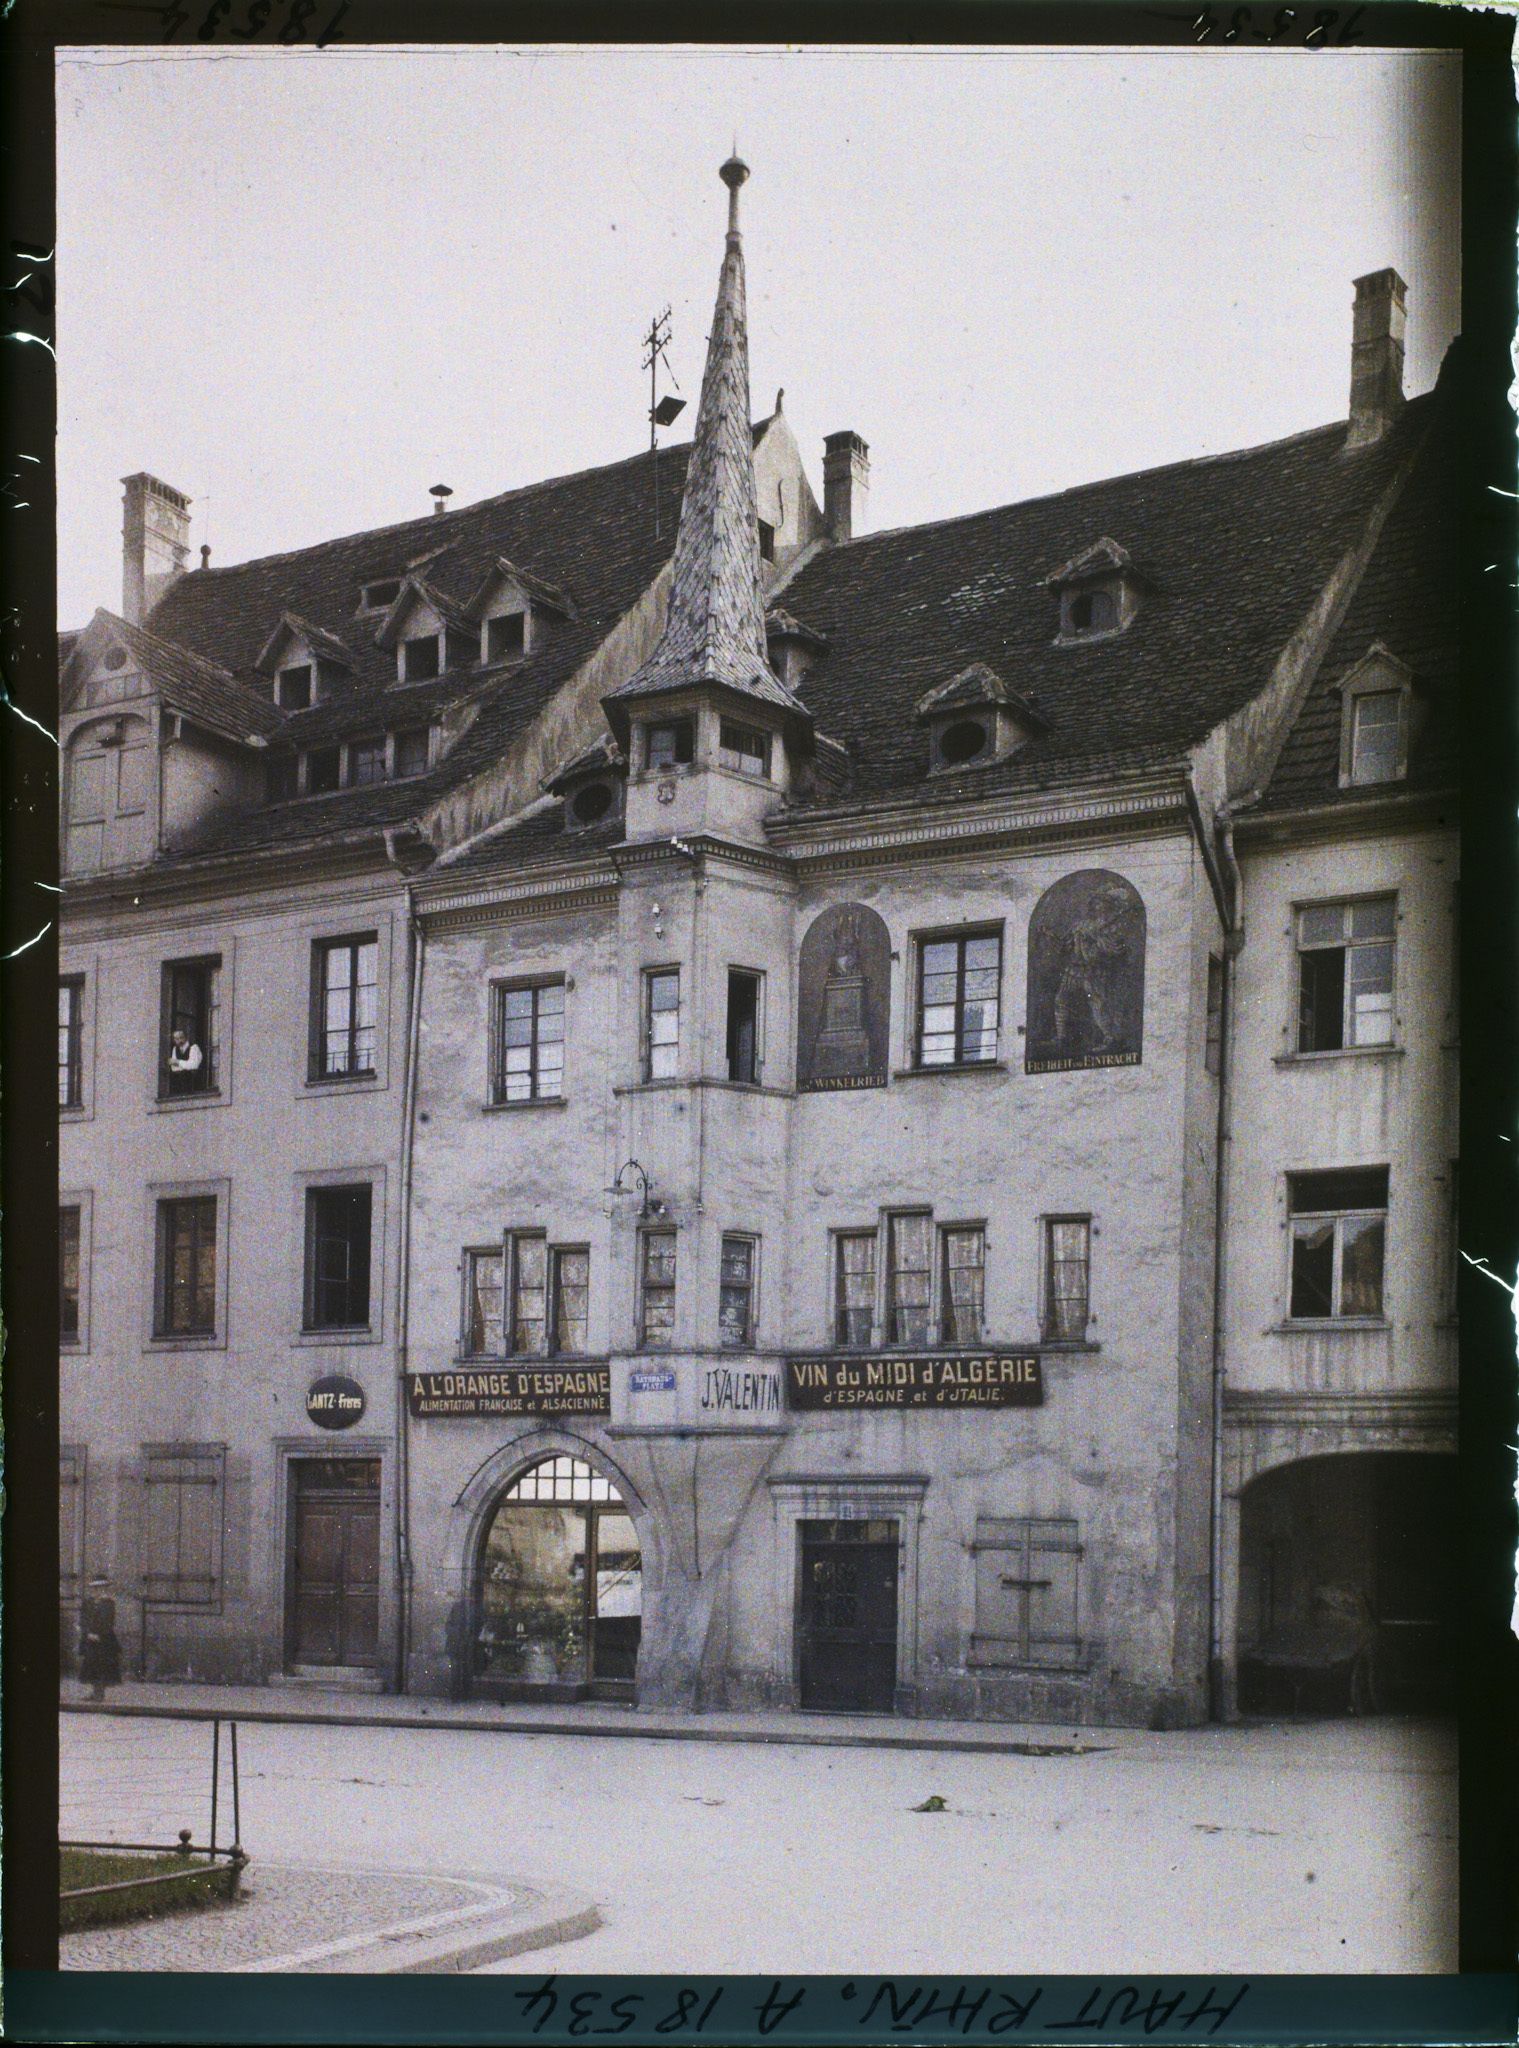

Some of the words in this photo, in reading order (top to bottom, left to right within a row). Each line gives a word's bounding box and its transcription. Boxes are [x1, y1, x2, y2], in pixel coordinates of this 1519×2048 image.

[1028, 1058, 1072, 1073] FREIHEIT
[1084, 1052, 1138, 1067] EINTRACHT
[815, 1075, 885, 1089] WINKELRIED
[793, 1363, 828, 1387] VIN
[836, 1364, 860, 1386] du
[867, 1361, 915, 1385] MIDI
[922, 1357, 1037, 1385] d'ALGÉRIE
[413, 1373, 426, 1396] À
[430, 1374, 511, 1396] L'ORANGE
[518, 1372, 611, 1395] D'ESPAGNE
[824, 1389, 904, 1403] d'ESPAGNE
[913, 1390, 927, 1402] et
[419, 1399, 476, 1412] ALIMENTATION
[479, 1399, 523, 1413] FRANÇAISE
[526, 1401, 537, 1411] et
